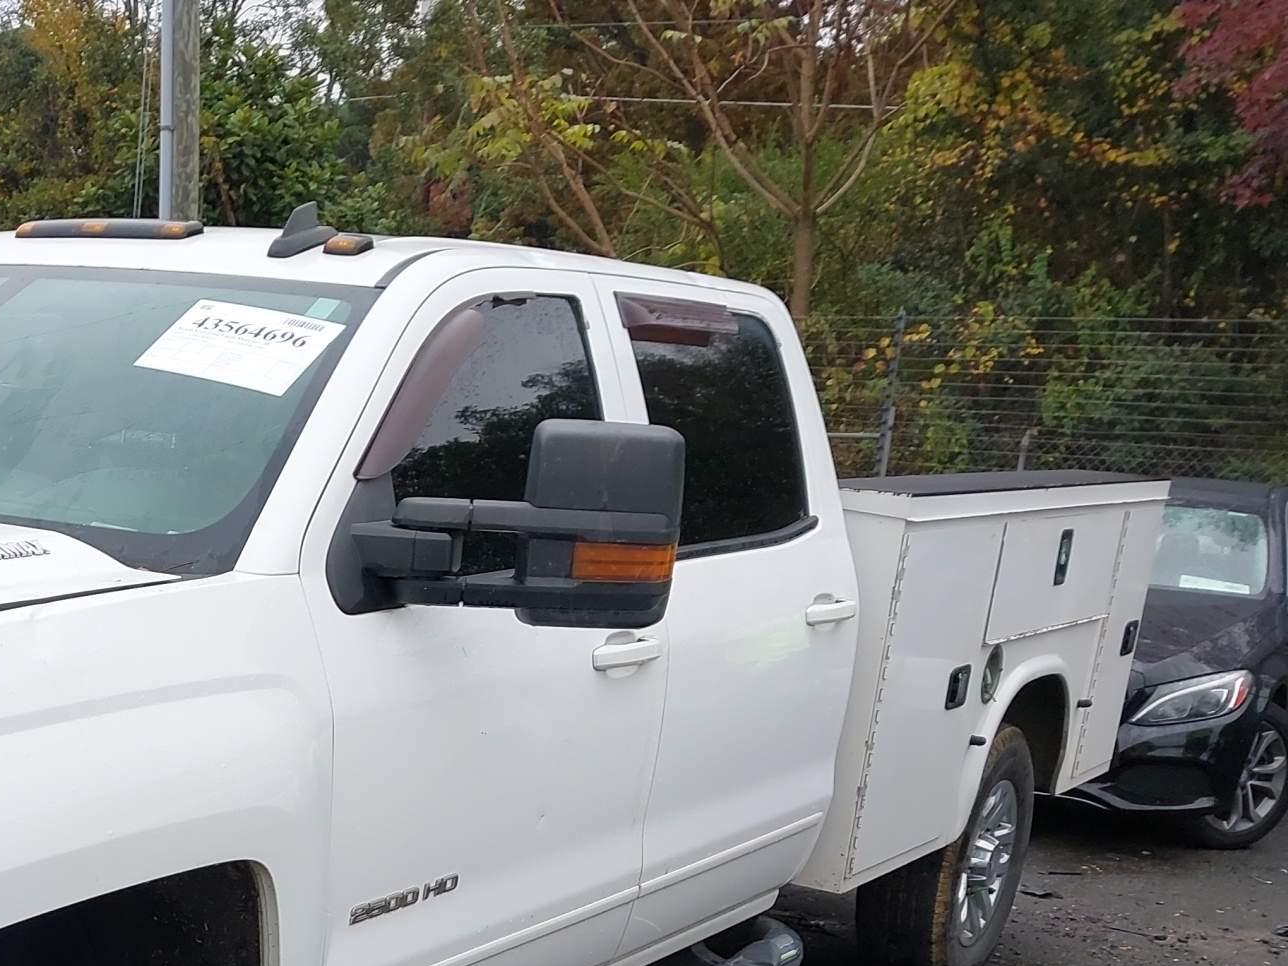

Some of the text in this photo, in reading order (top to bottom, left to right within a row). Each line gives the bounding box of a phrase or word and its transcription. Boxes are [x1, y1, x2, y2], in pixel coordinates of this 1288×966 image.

[191, 315, 312, 349] 43564696
[349, 872, 460, 926] 2500 HD
